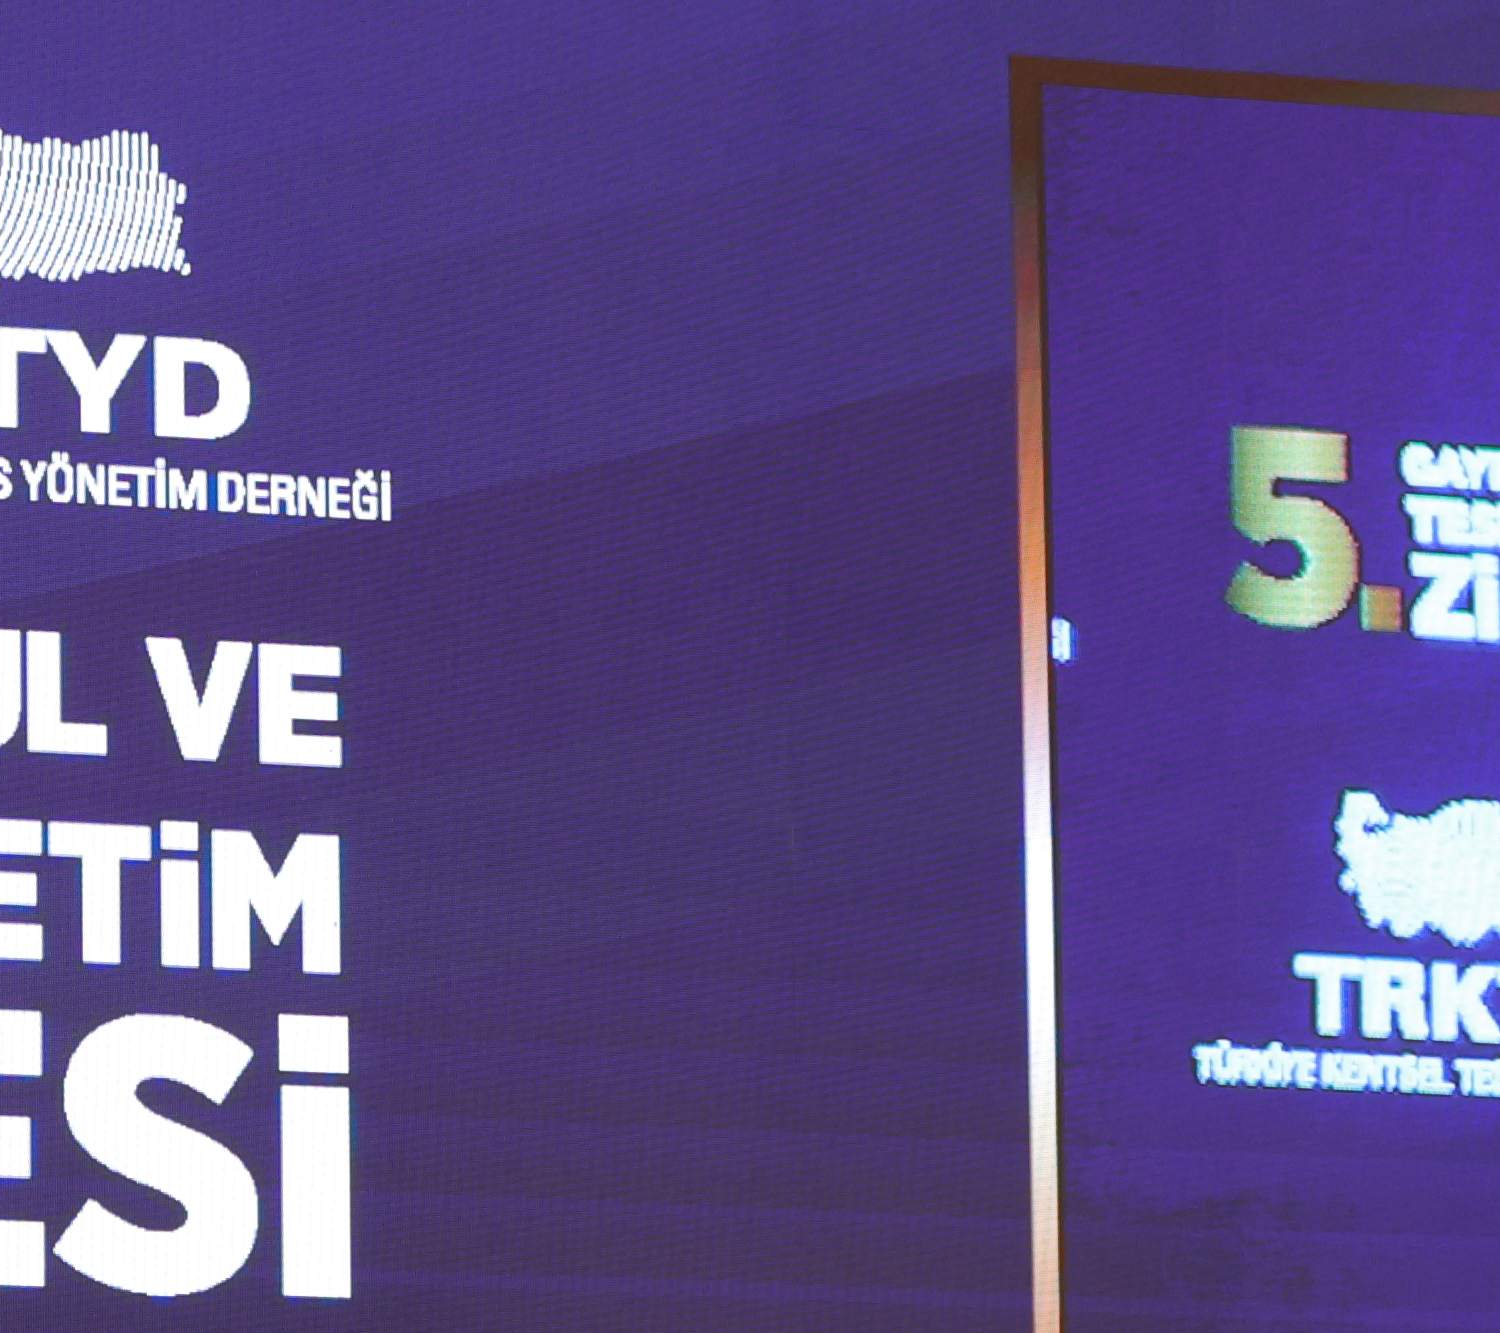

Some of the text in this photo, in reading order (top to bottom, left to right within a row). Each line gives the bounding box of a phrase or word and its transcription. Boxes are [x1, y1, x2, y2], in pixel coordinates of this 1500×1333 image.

[21, 453, 208, 511] YÖNETİM
[218, 470, 392, 522] DERNEĞİ
[1227, 427, 1402, 630] 5.
[147, 638, 343, 768] VE
